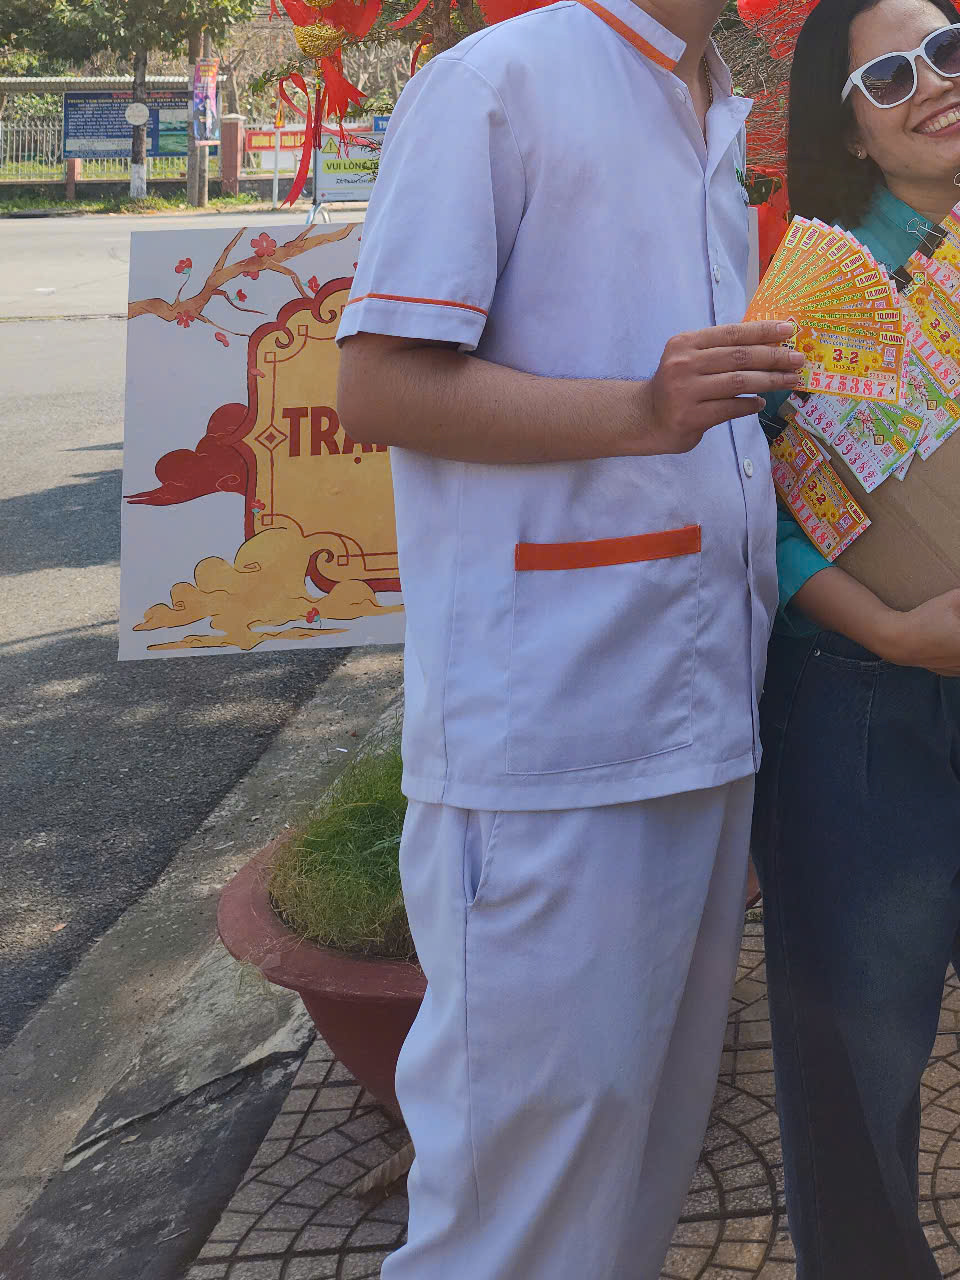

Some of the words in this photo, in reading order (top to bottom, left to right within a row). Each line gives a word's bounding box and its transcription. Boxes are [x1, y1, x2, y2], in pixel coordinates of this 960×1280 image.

[326, 162, 341, 170] VUI
[929, 319, 951, 341] 3-2
[832, 348, 858, 363] 3-2
[811, 372, 885, 396] 575387
[806, 480, 827, 505] 3-2
